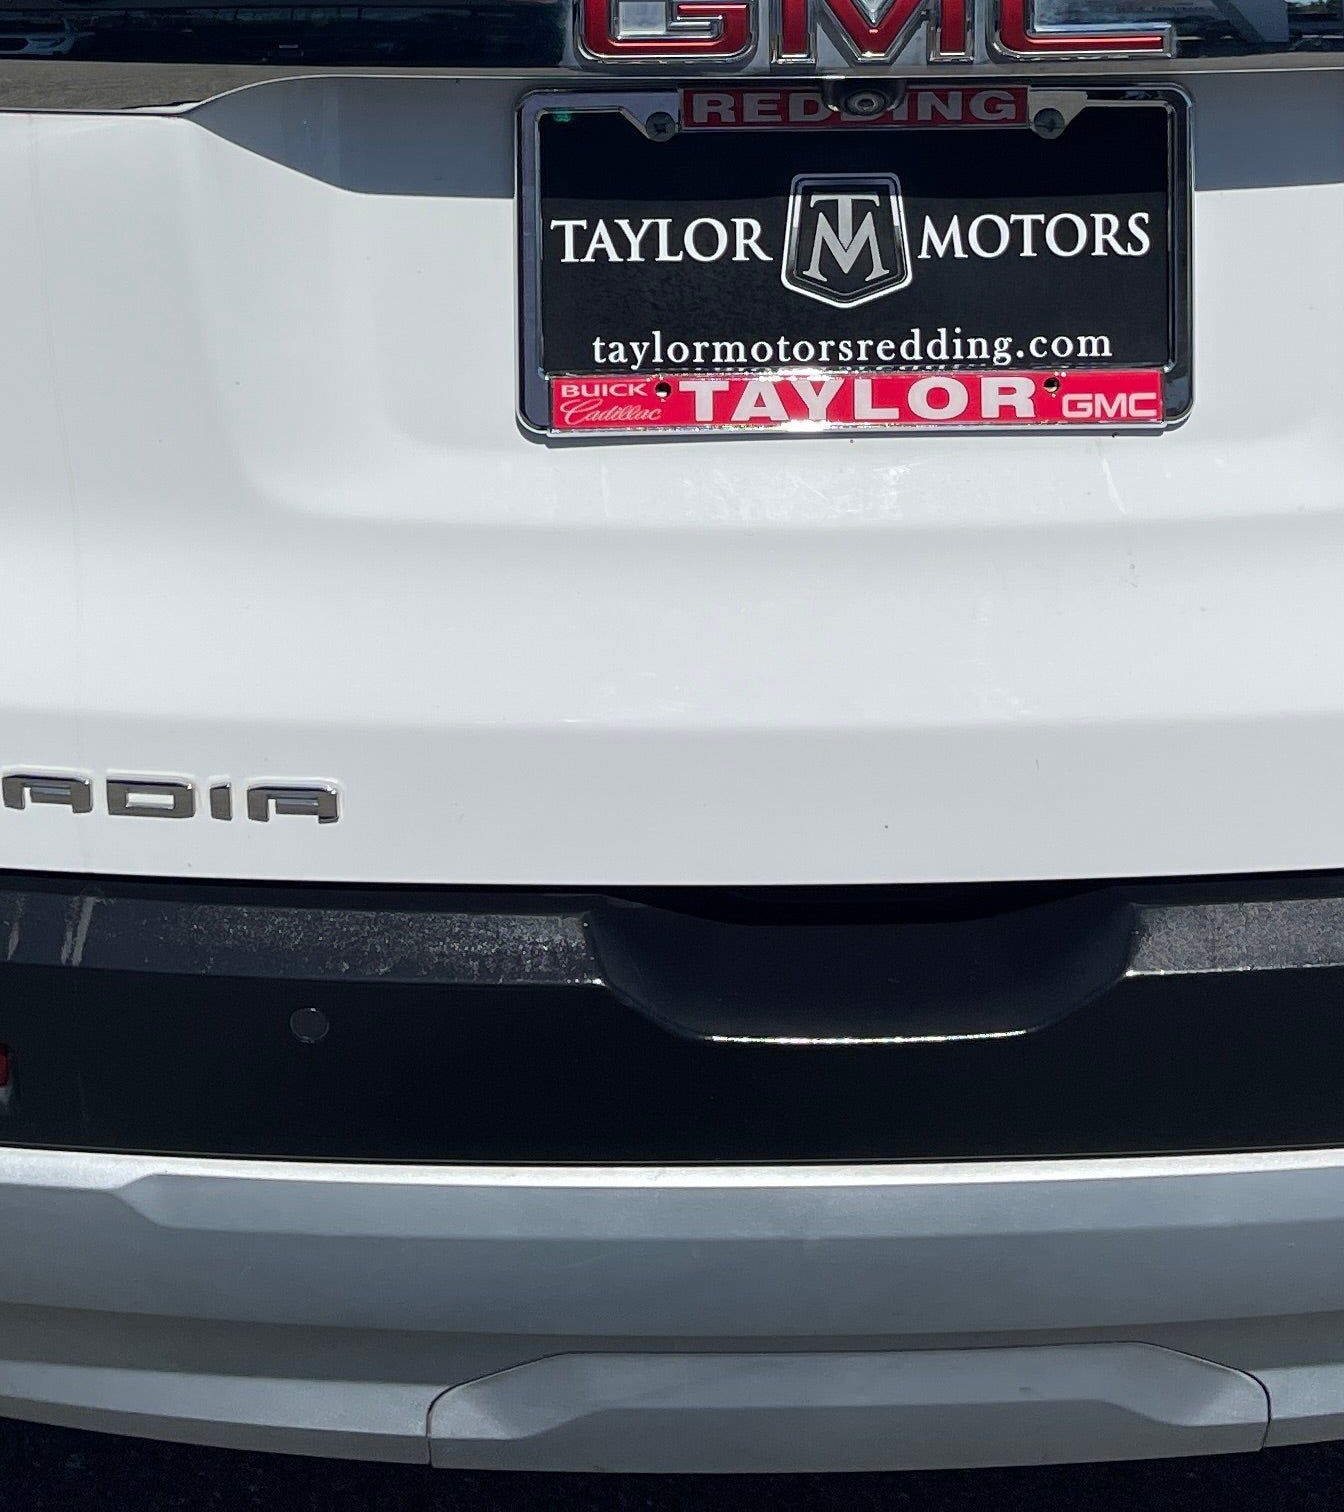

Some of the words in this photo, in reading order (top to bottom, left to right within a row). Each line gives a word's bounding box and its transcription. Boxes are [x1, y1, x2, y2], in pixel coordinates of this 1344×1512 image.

[550, 218, 774, 263] TAYLOR
[917, 212, 1151, 259] MOTORS
[592, 327, 1113, 370] taylormotorsredding.com
[560, 383, 648, 398] BUICK
[678, 375, 1036, 422] TAYLOR
[1061, 392, 1157, 418] GMC
[559, 399, 662, 426] Cadillac
